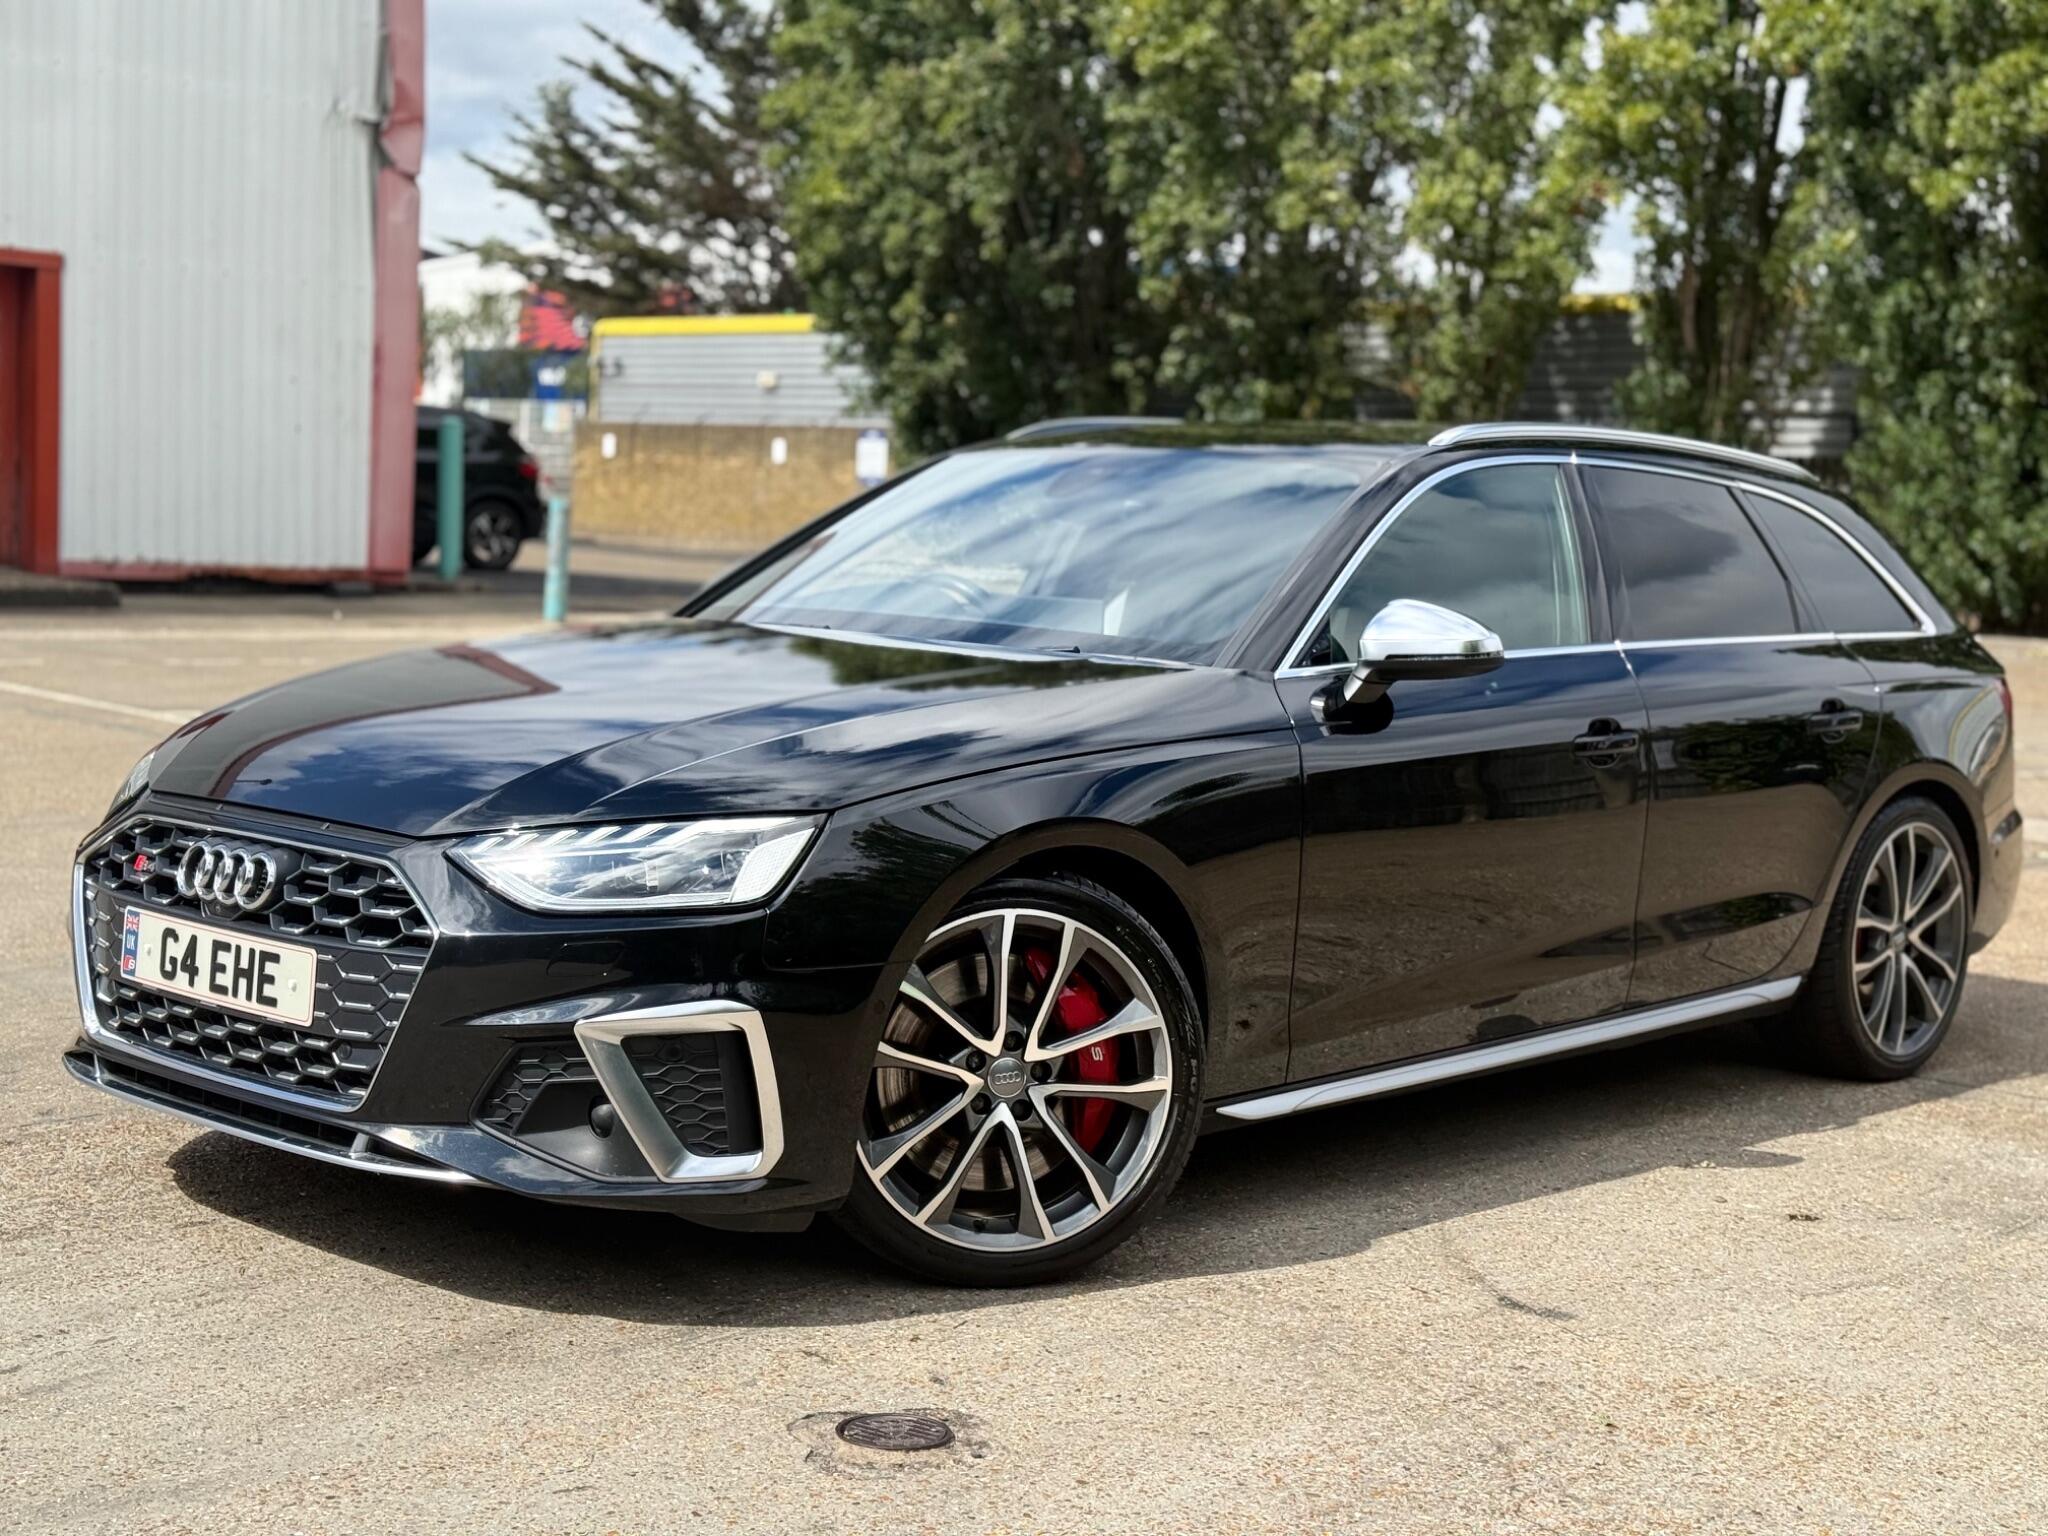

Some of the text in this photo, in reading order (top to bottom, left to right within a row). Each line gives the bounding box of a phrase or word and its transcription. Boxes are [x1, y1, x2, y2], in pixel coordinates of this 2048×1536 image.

[126, 933, 137, 950] UK
[159, 927, 281, 1008] G4 EHE
